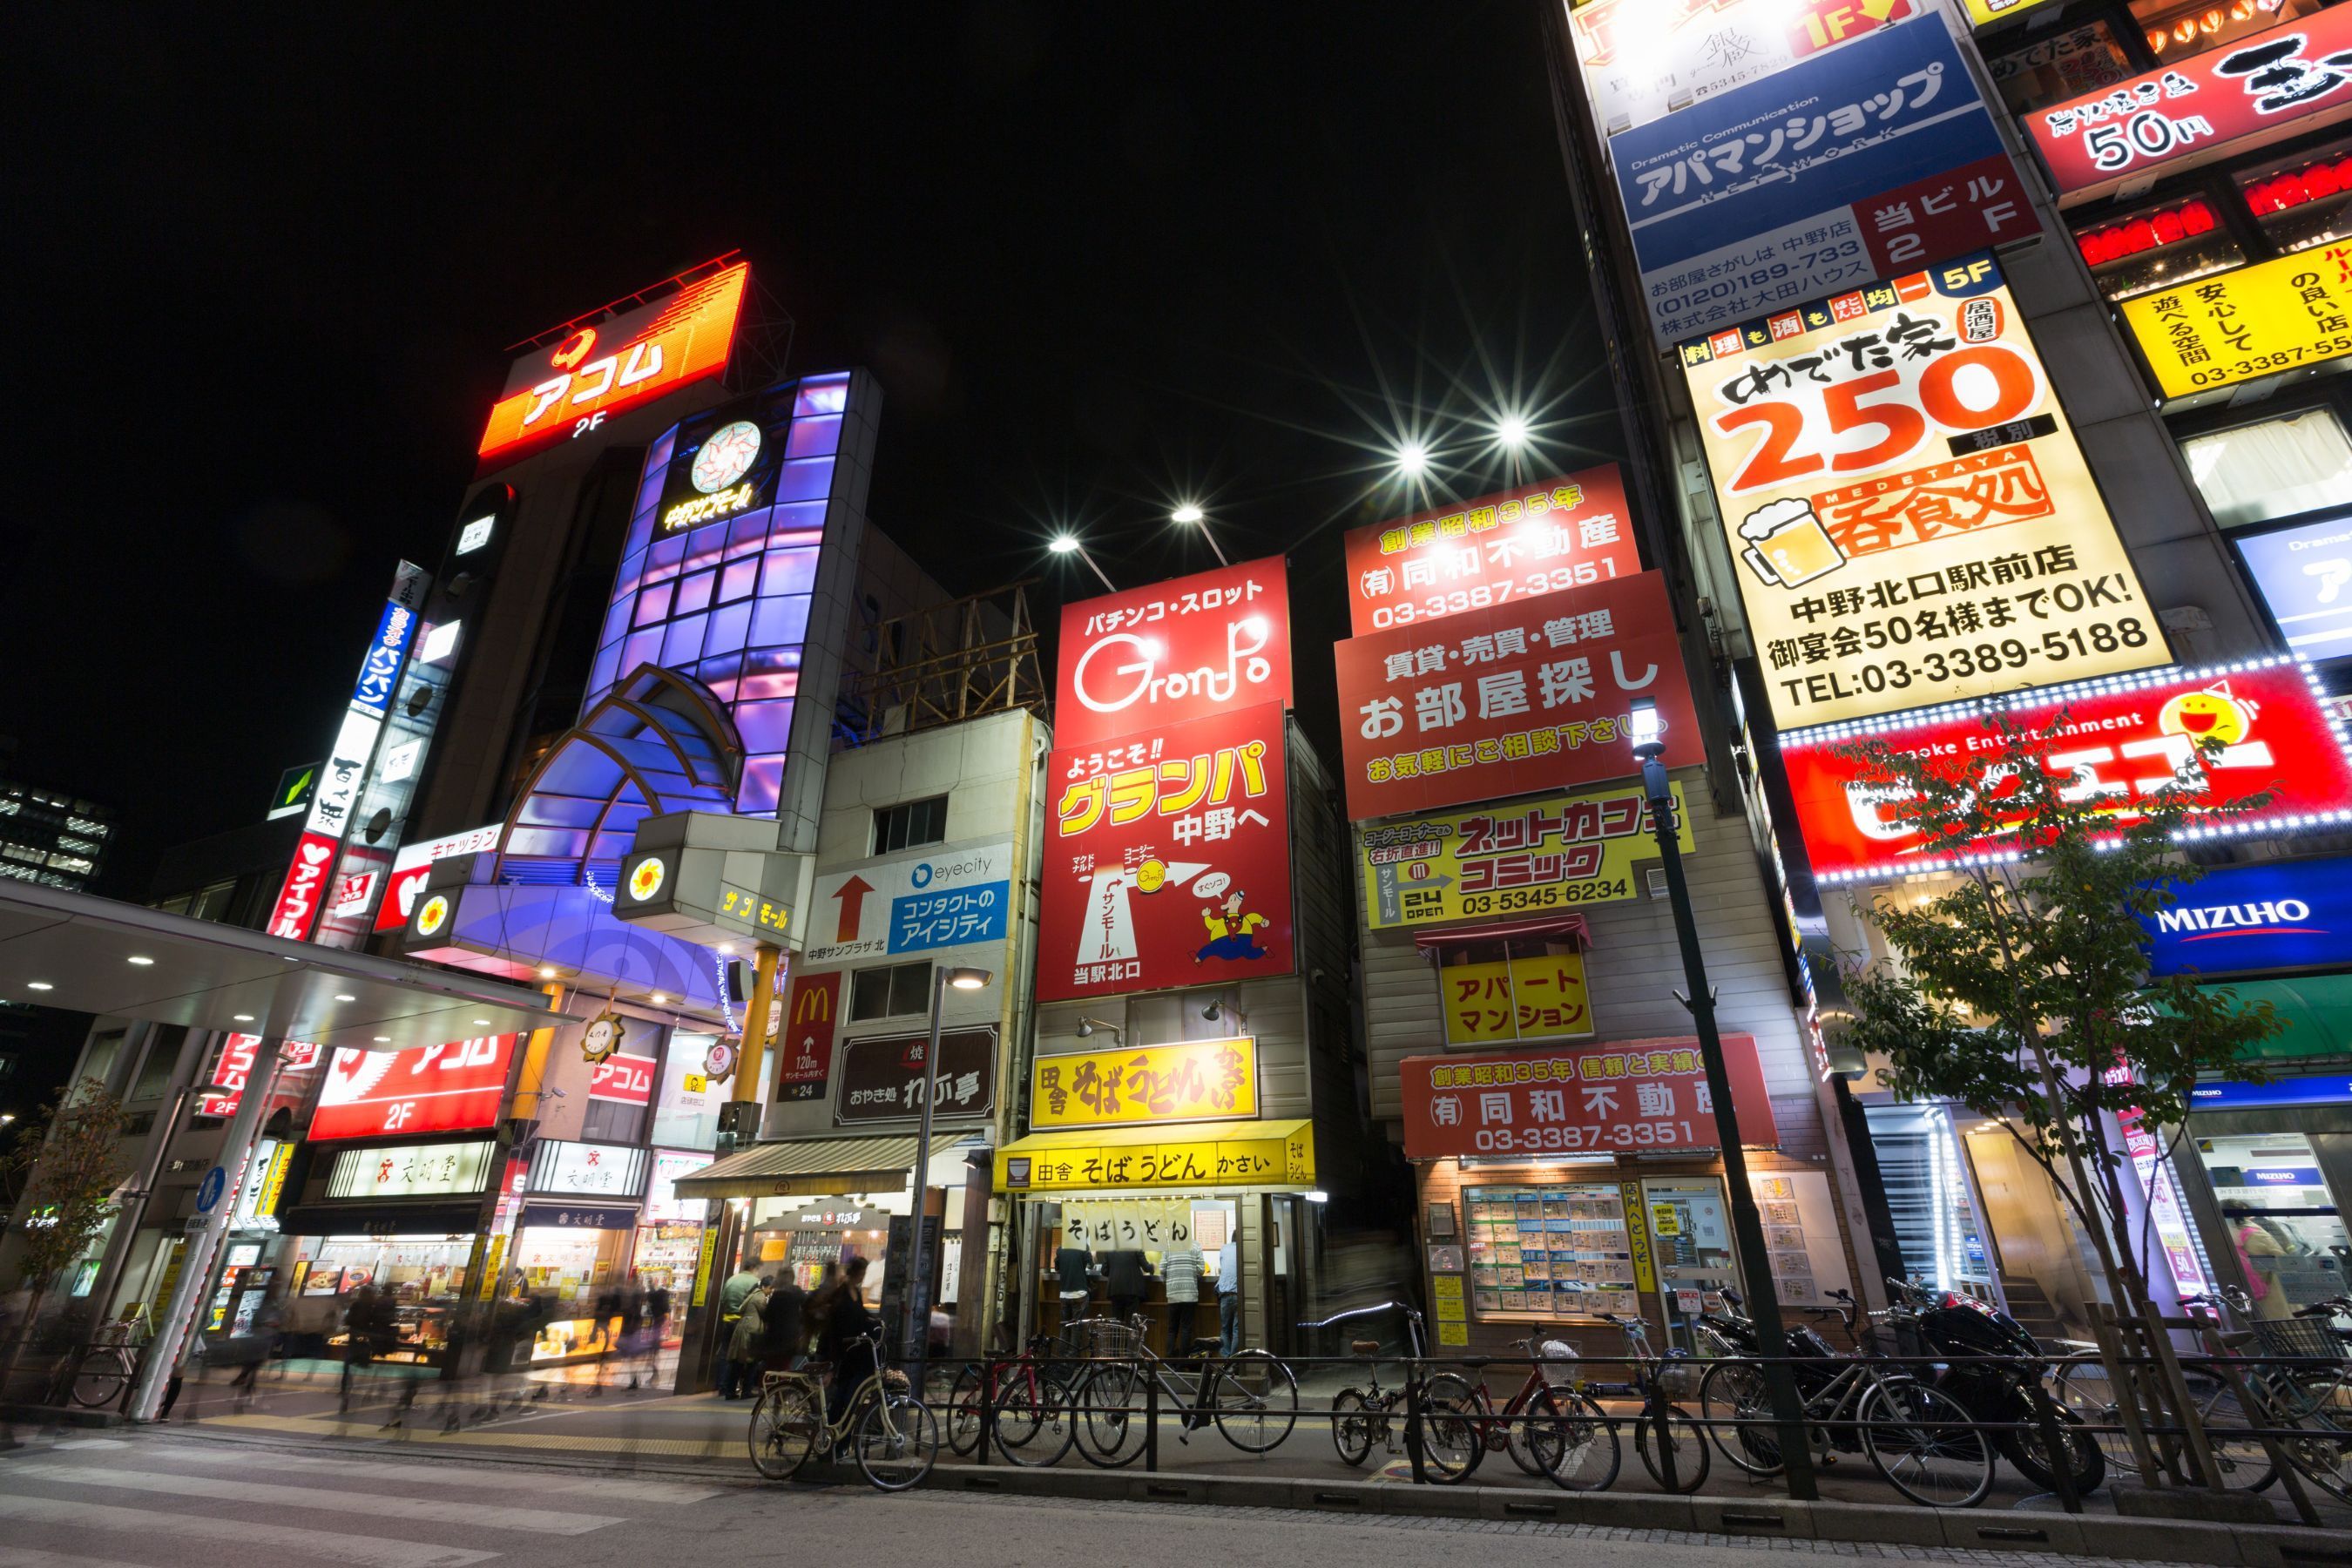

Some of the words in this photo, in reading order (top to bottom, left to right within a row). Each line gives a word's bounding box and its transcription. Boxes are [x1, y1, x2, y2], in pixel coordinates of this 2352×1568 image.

[1794, 9, 1859, 51] 1F
[1631, 139, 1699, 171] Dramatic
[1702, 96, 1819, 144] Communication
[1635, 62, 1943, 206] アパマンショップ
[2083, 110, 2214, 171] 50円
[1701, 126, 1896, 204] NETWORK
[1874, 176, 2004, 233] 当ビル
[1887, 233, 1925, 263] 2
[1983, 202, 2017, 233] F
[1651, 235, 1776, 298] お部屋さがしは
[1783, 220, 1852, 253] 中野店
[1656, 240, 1860, 318] (0120)189-733
[1943, 260, 1992, 290] 5F
[1660, 261, 1869, 336] 株式会社大田ハウス
[1967, 301, 1995, 341] 居酒屋
[2195, 283, 2253, 351] 安心して
[2291, 272, 2349, 333] の良い店
[2151, 296, 2212, 367] 遊べる空間
[524, 342, 663, 426] アコム
[1721, 313, 1957, 404] めでた家
[2191, 335, 2352, 386] 03-3387-55
[573, 410, 606, 438] 2F
[1716, 346, 2036, 492] 250
[1826, 449, 2017, 504] MEDETAYA
[1380, 484, 1584, 555] 創業昭和35年
[1085, 579, 1264, 636] パチンコ・スロット
[1372, 557, 1618, 629] 03-3387-3351
[1790, 544, 2078, 625] 中野北口駅前店
[383, 607, 410, 647] カラオケ
[1383, 608, 1615, 683] 賃貸・売買・管理
[1767, 573, 2132, 671] 御宴会50名様までOK!
[358, 645, 401, 703] バンバン
[1781, 618, 2149, 706] TEL:03-3389-5188
[1359, 650, 1659, 740] お部屋探し
[1058, 739, 1267, 837] グランパ
[1173, 808, 1270, 847] 中野へ
[935, 857, 992, 882] eyecity
[1381, 868, 1396, 918] サンモール
[1459, 843, 1605, 896] コミック
[277, 862, 321, 939] アイフル
[904, 889, 995, 920] コンタクトの
[1404, 890, 1442, 907] 24
[1462, 879, 1628, 916] 03-5345-6234
[2155, 899, 2310, 933] MIZUHO
[901, 916, 992, 947] アイシティ
[1099, 892, 1115, 959] サンモール
[1073, 961, 1140, 985] 当駅北口
[1456, 969, 1579, 1003] アパート
[1460, 1002, 1584, 1032] マンション
[592, 1064, 652, 1092] アコム
[796, 1054, 817, 1070] 120m
[1040, 1064, 1068, 1116] 田舎
[1071, 1054, 1206, 1116] そばうどん
[1431, 1054, 1572, 1088] 創業昭和35年
[213, 1101, 237, 1113] 2F
[384, 1102, 416, 1130] 2F
[799, 1084, 813, 1098] 24
[849, 1086, 897, 1106] おやき処
[1289, 1142, 1303, 1159] そば
[1476, 1120, 1694, 1152] 03-3387-3351
[400, 1155, 456, 1183] 文明堂
[566, 1169, 613, 1189] 文明堂
[1038, 1162, 1073, 1181] 田舎
[1217, 1154, 1271, 1174] かさい
[1289, 1163, 1307, 1181] うどん
[1067, 1220, 1189, 1244] そばうどん
